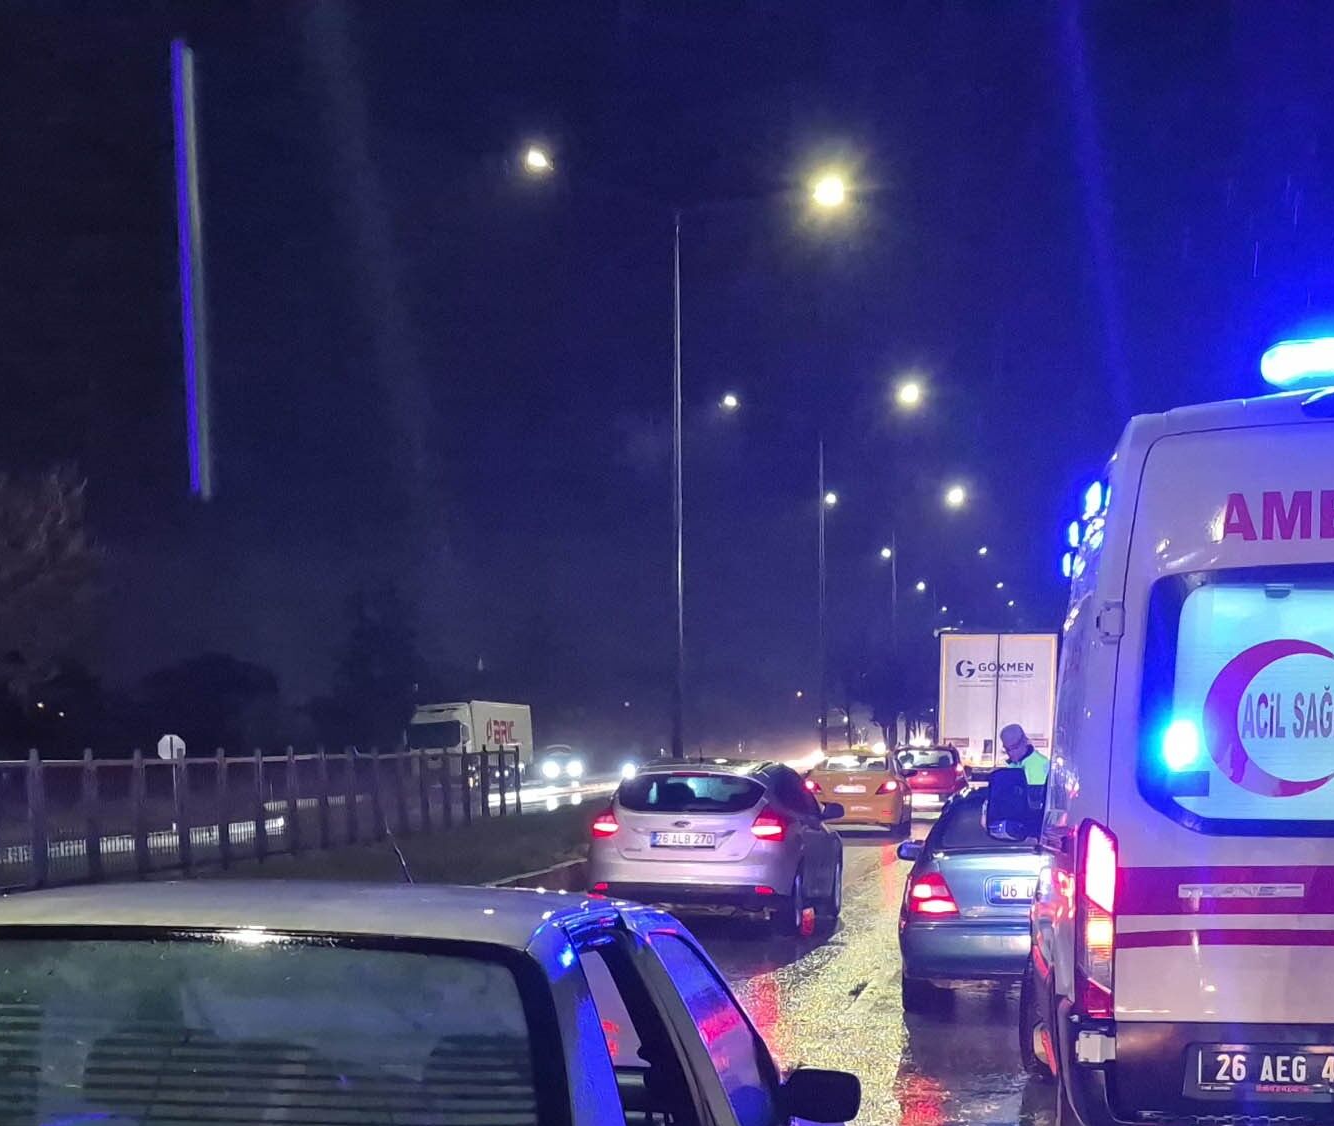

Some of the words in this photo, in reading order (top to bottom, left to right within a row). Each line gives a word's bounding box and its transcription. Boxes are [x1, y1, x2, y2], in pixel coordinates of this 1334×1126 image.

[694, 834, 713, 844] 270
[1215, 1054, 1246, 1081] 26
[1260, 1055, 1307, 1082] AEG
